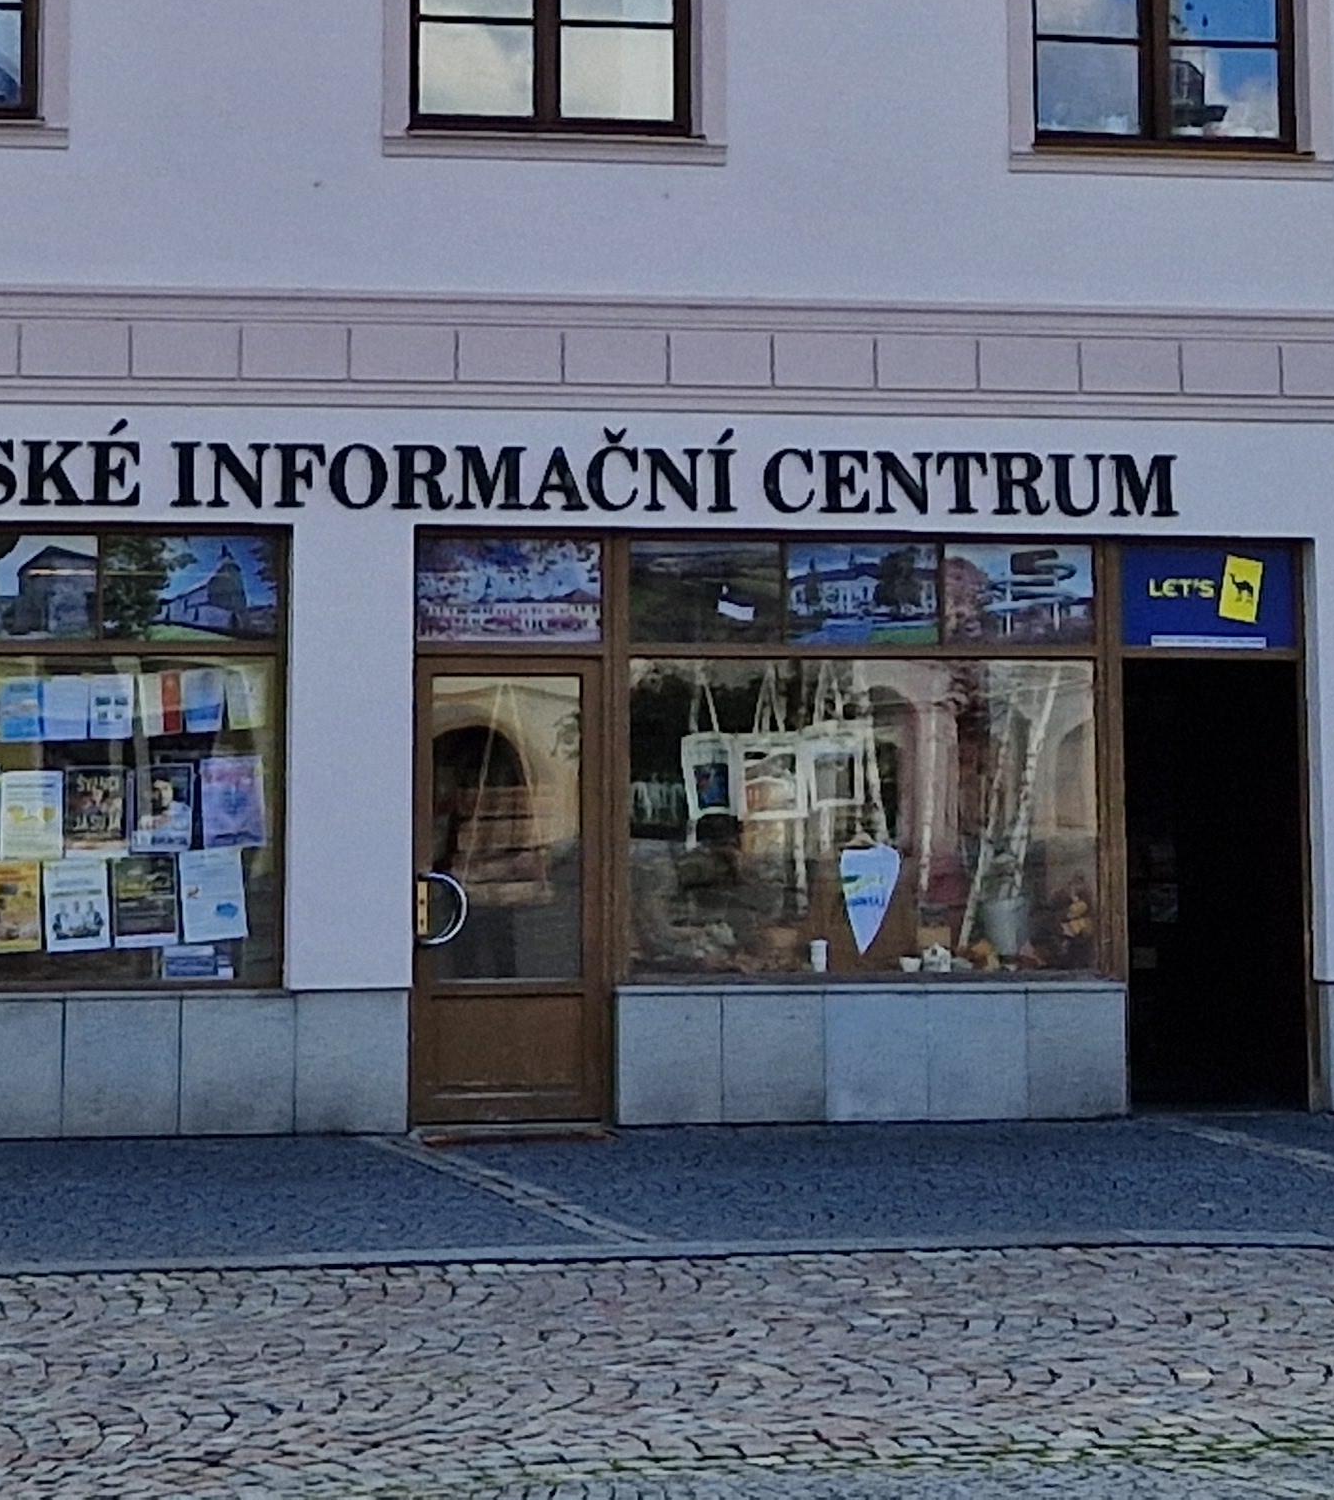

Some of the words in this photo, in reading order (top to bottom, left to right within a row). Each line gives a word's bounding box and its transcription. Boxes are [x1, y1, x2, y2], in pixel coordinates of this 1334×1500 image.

[170, 426, 738, 513] INFORMAČNÍ
[763, 448, 1180, 518] CENTRUM
[1148, 577, 1216, 599] LET'S
